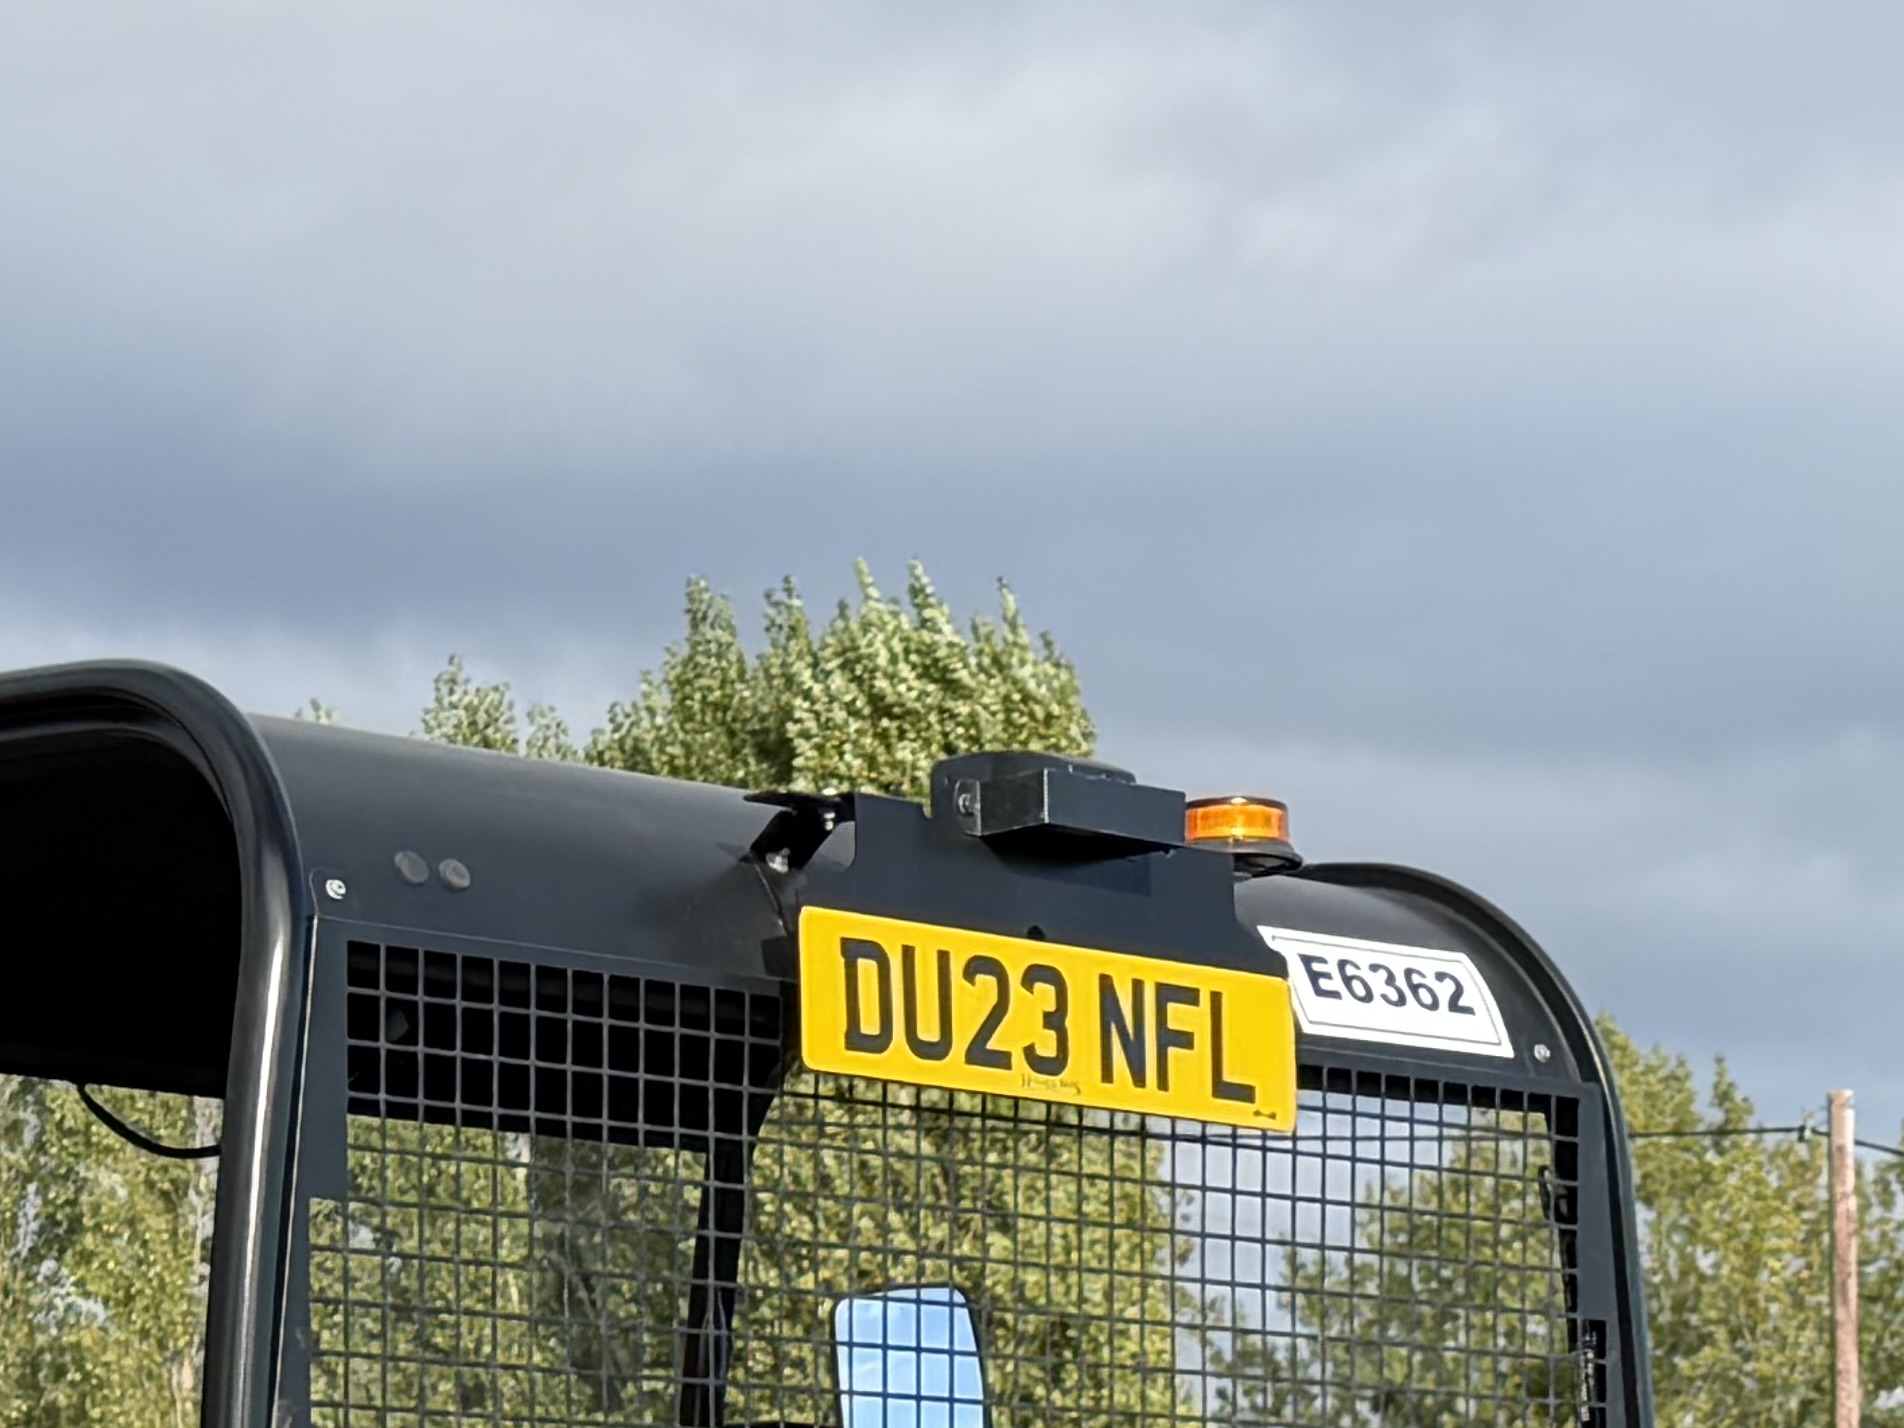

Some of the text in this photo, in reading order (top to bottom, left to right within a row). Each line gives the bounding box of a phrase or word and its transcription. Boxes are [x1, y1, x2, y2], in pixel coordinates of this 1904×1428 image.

[840, 937, 1256, 1103] DU23 NFL
[1299, 953, 1476, 1015] E6362
